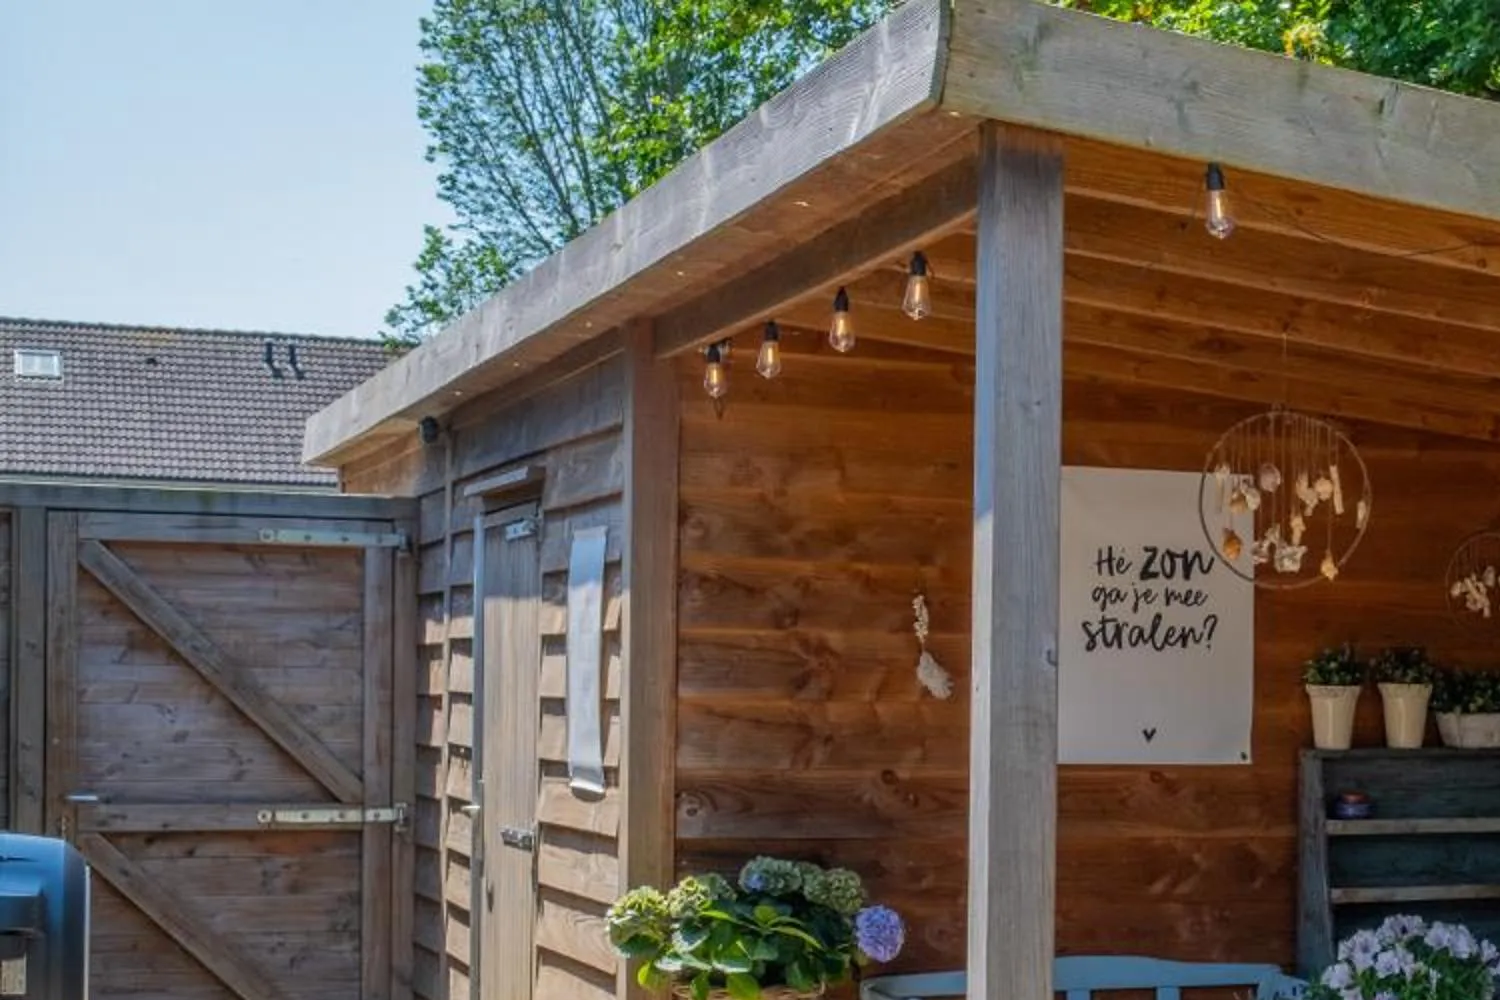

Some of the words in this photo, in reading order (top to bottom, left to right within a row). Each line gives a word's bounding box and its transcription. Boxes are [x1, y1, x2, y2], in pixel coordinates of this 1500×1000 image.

[1139, 546, 1215, 581] zon
[1091, 586, 1128, 613] ga
[1131, 582, 1159, 614] je
[1164, 586, 1209, 608] mee
[1081, 612, 1219, 652] stralen?
